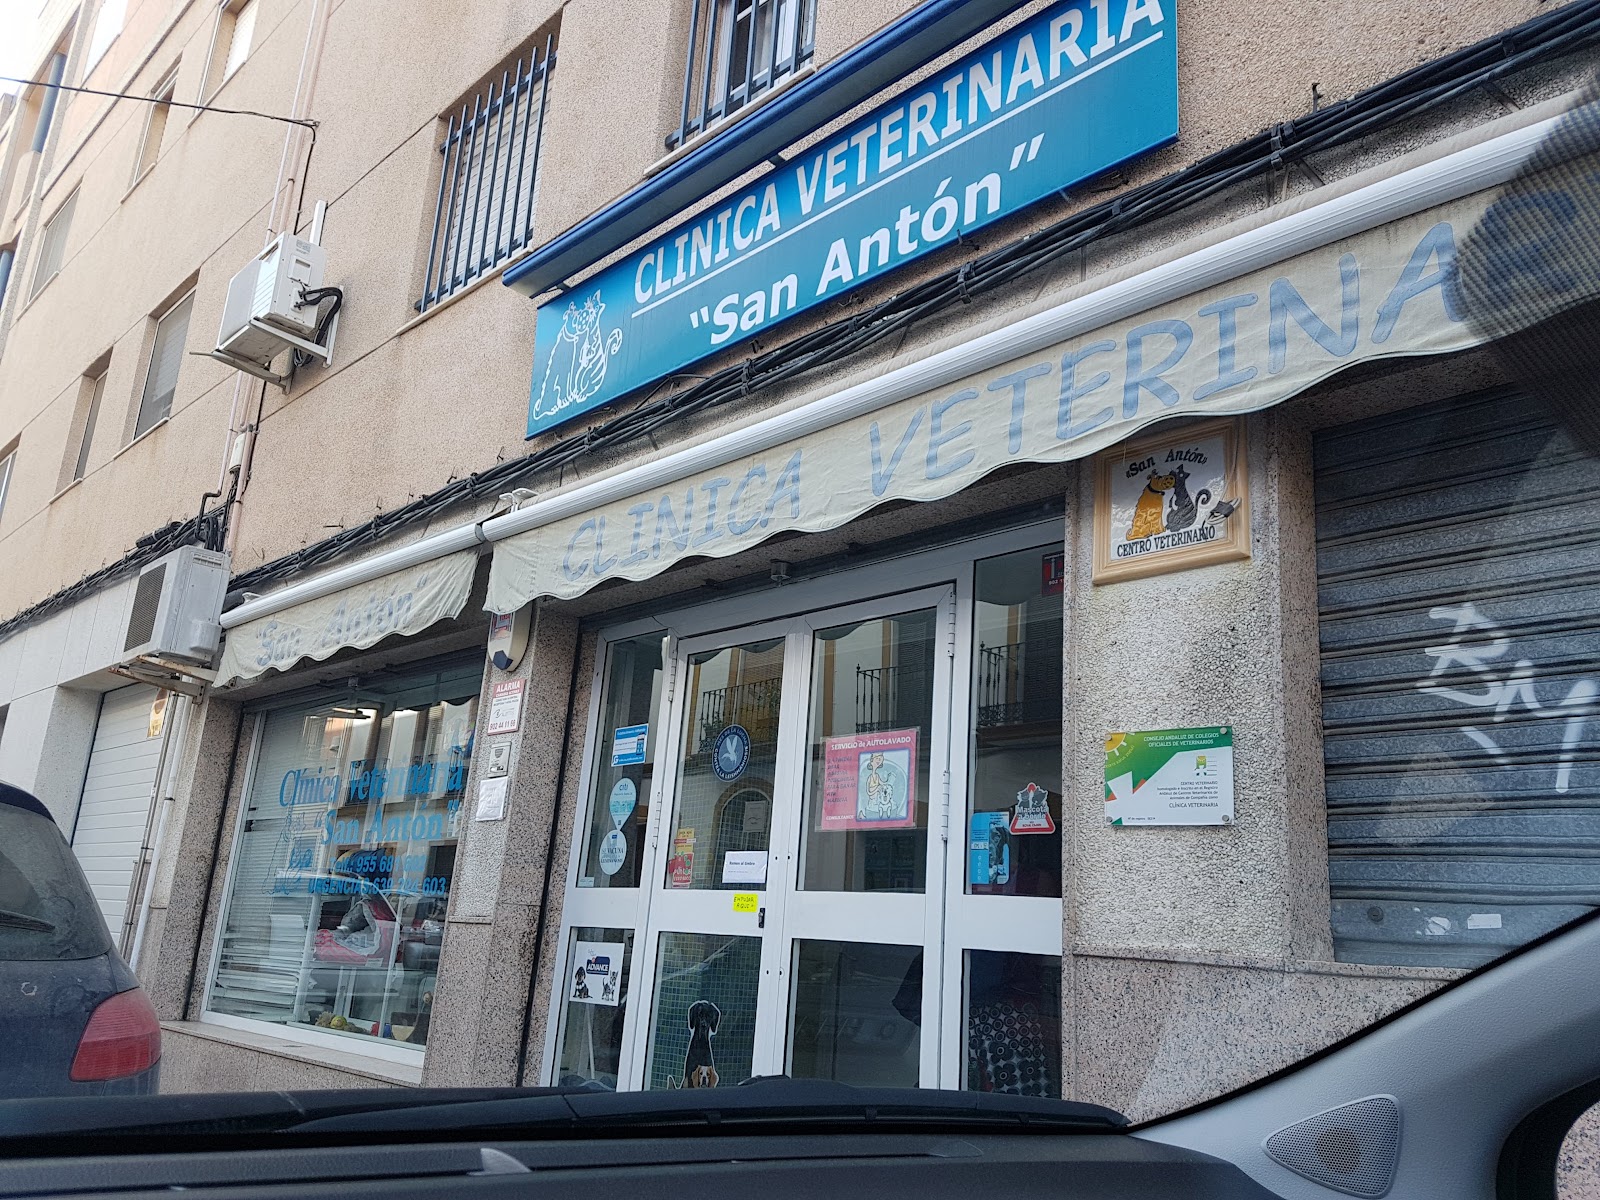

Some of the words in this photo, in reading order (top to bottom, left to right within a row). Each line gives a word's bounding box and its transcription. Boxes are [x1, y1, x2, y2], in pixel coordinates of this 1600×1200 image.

[634, 195, 782, 304] CLINICA
[795, 0, 1165, 217] VETERINARIA
[562, 448, 803, 582] CLINICA
[1117, 538, 1152, 558] CENTRO
[1153, 525, 1216, 549] VETERINARIO
[496, 681, 520, 693] ALARMA
[831, 742, 858, 750] SERVICIO
[858, 740, 866, 748] de
[866, 736, 912, 747] AUTOLAVADO
[279, 766, 340, 808] Clínica
[1016, 804, 1048, 813] Mascota
[356, 855, 376, 874] 955
[422, 876, 448, 896] 603
